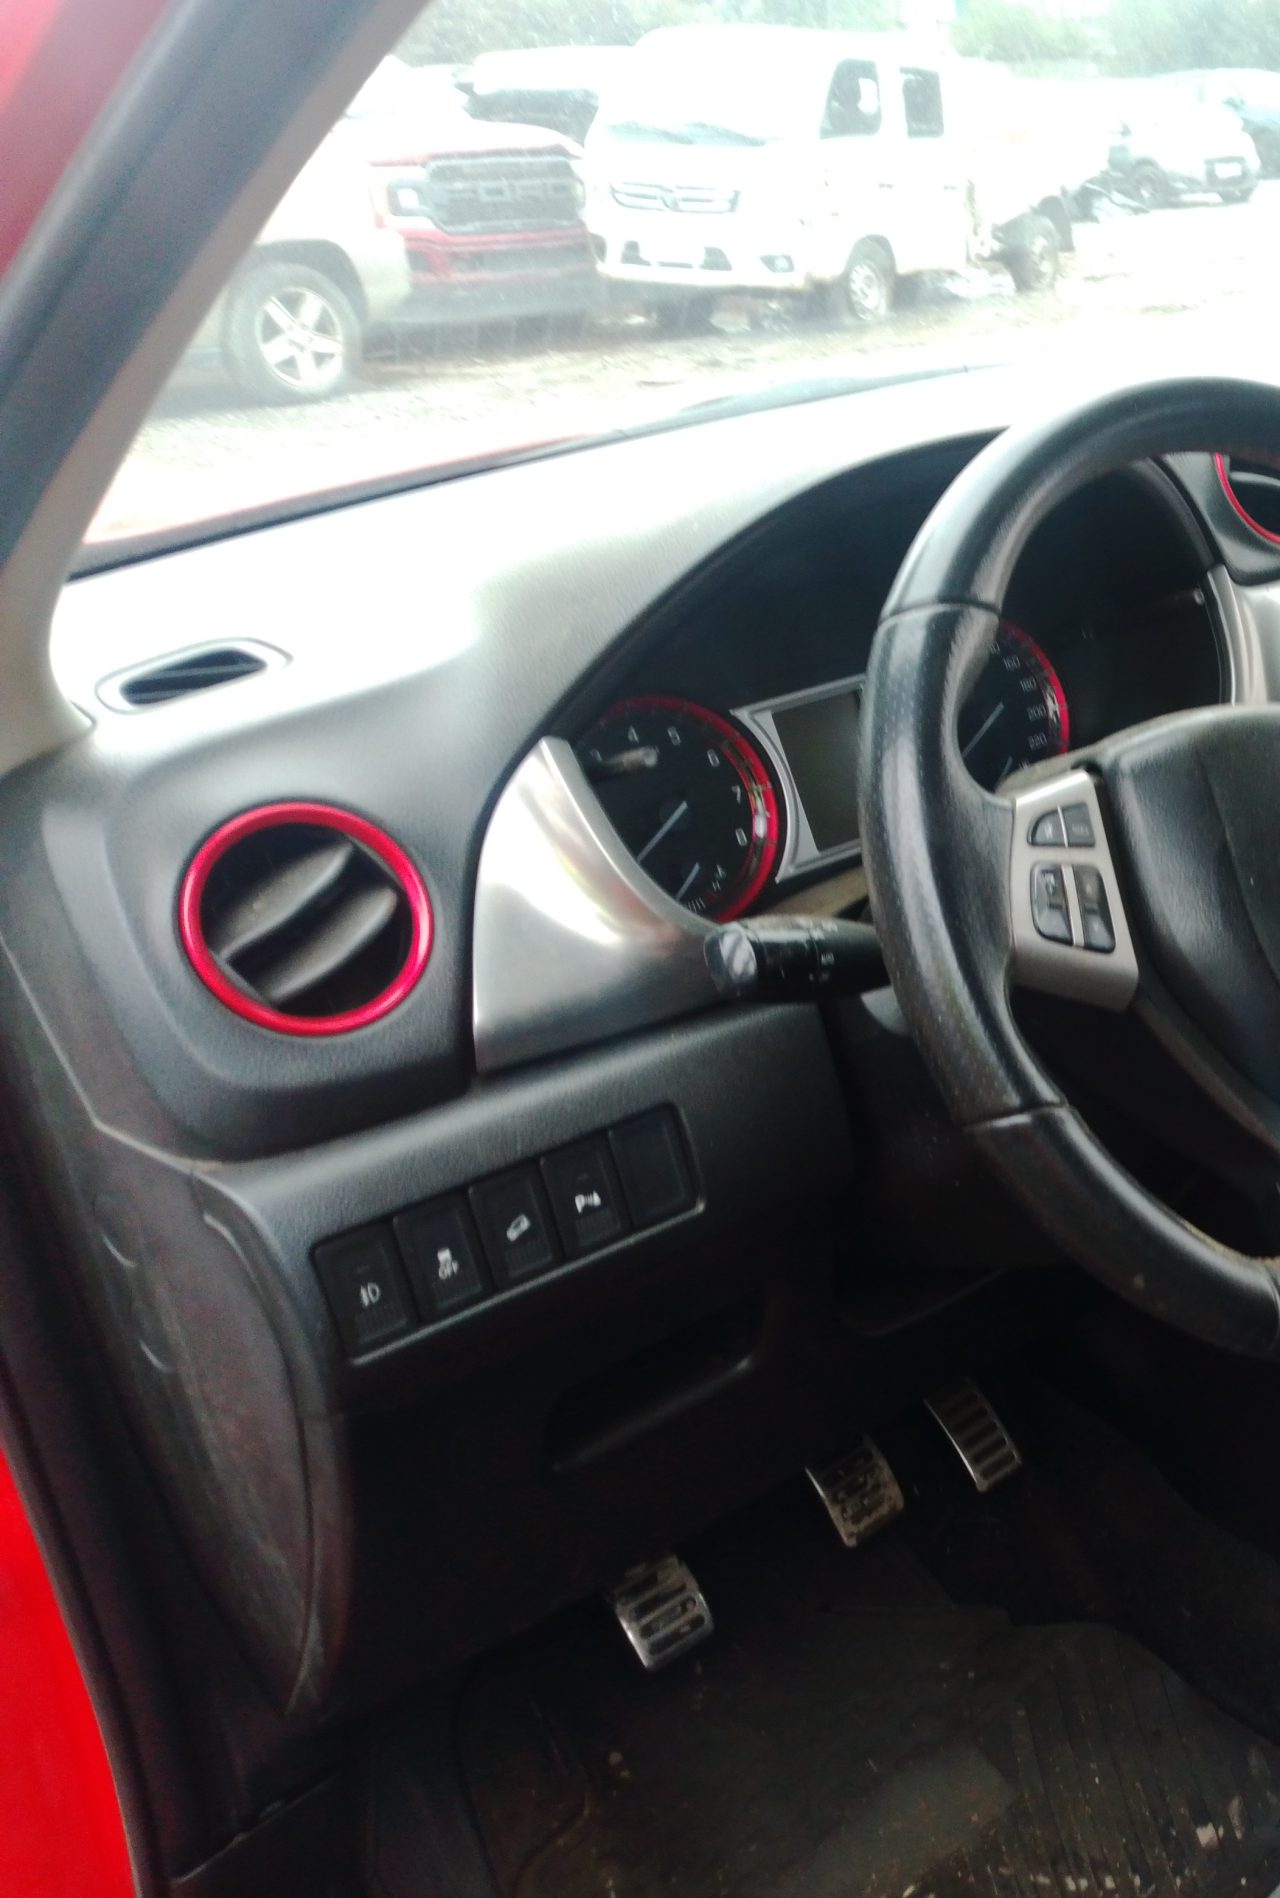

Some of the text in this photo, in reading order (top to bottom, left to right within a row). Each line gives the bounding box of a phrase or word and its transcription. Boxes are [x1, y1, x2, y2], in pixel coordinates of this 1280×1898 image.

[440, 175, 574, 205] FORD
[628, 725, 640, 743] 4
[667, 726, 681, 746] 5
[707, 749, 720, 767] 6
[731, 785, 741, 804] 7
[735, 828, 748, 847] 8
